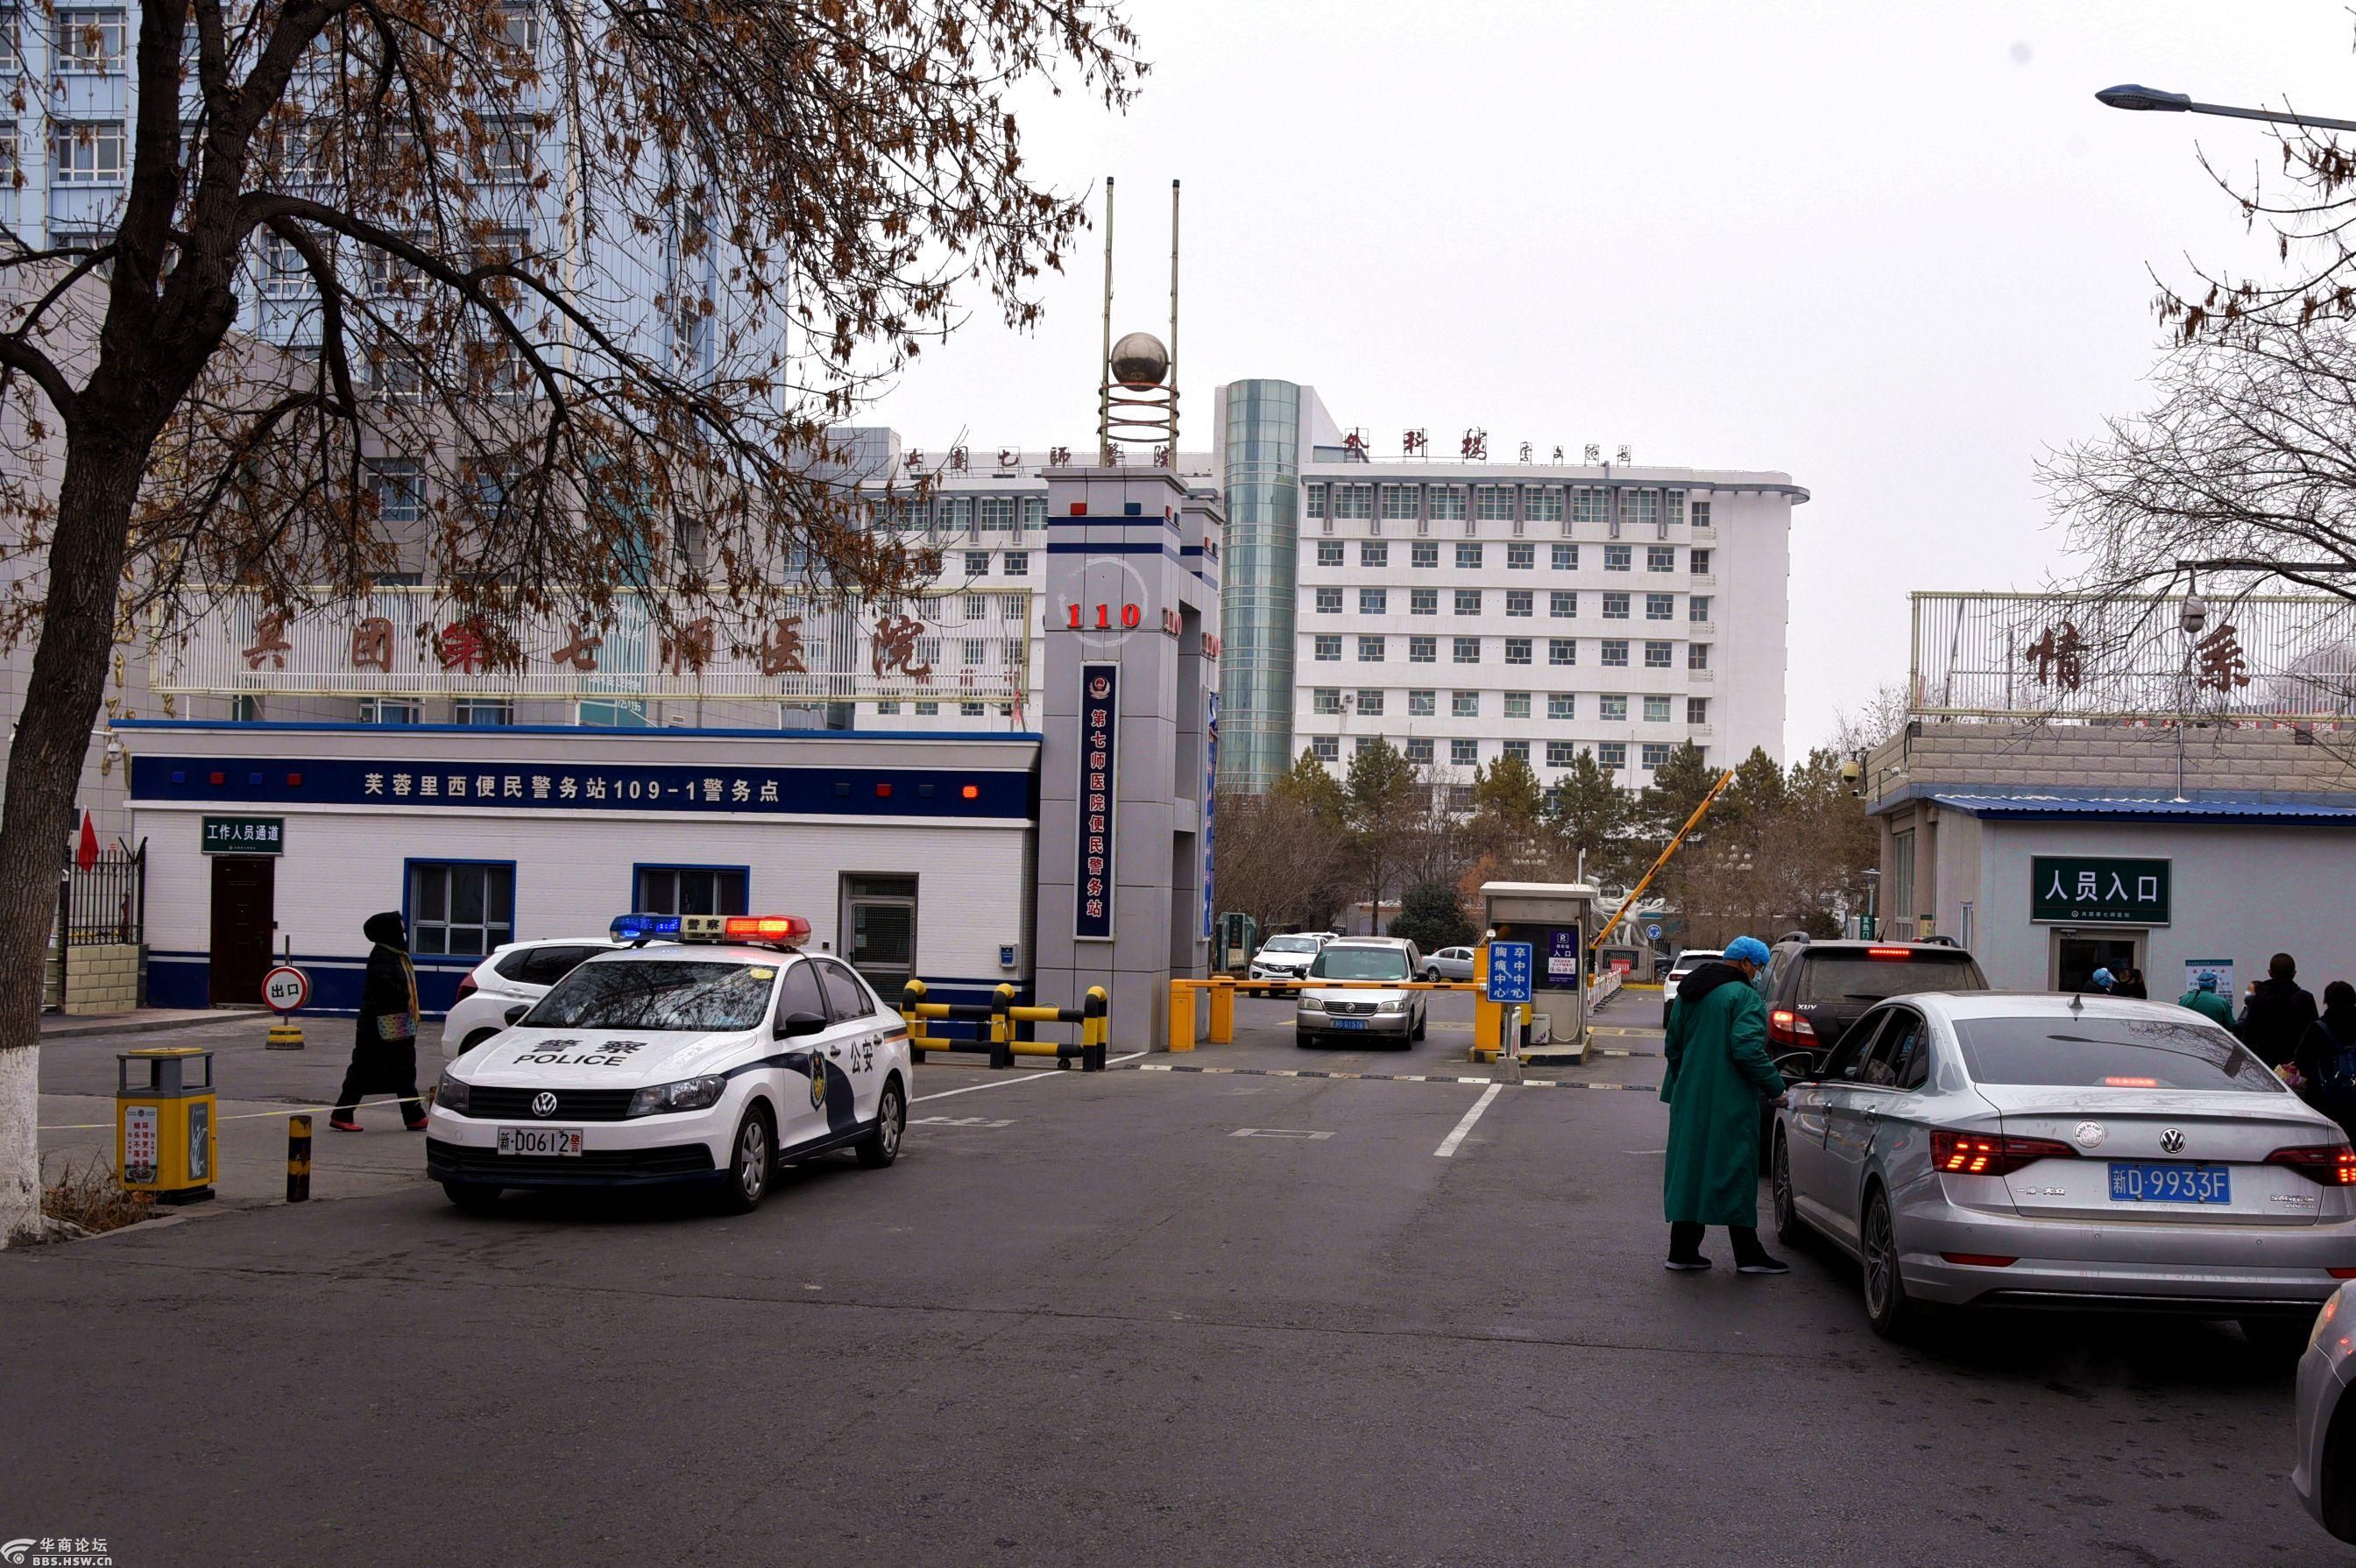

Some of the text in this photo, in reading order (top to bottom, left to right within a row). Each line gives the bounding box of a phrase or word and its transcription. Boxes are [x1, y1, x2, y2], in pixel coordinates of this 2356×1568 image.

[1066, 603, 1140, 629] 110
[364, 773, 779, 802] 芙蓉里西便民警务站109-1警务点
[1086, 709, 1107, 918] 第七师医院便民警务站
[207, 824, 279, 840] 工作人员通道
[2045, 870, 2157, 901] 人员入口
[687, 919, 719, 930] 警察
[1862, 916, 1871, 941] 发热门
[1493, 946, 1507, 998] 胸痛中心
[1511, 947, 1526, 999] 卒中中心
[271, 981, 300, 998] 出口
[531, 1039, 648, 1054] 警察
[850, 1038, 874, 1074] 公安
[513, 1054, 627, 1066] POLICE
